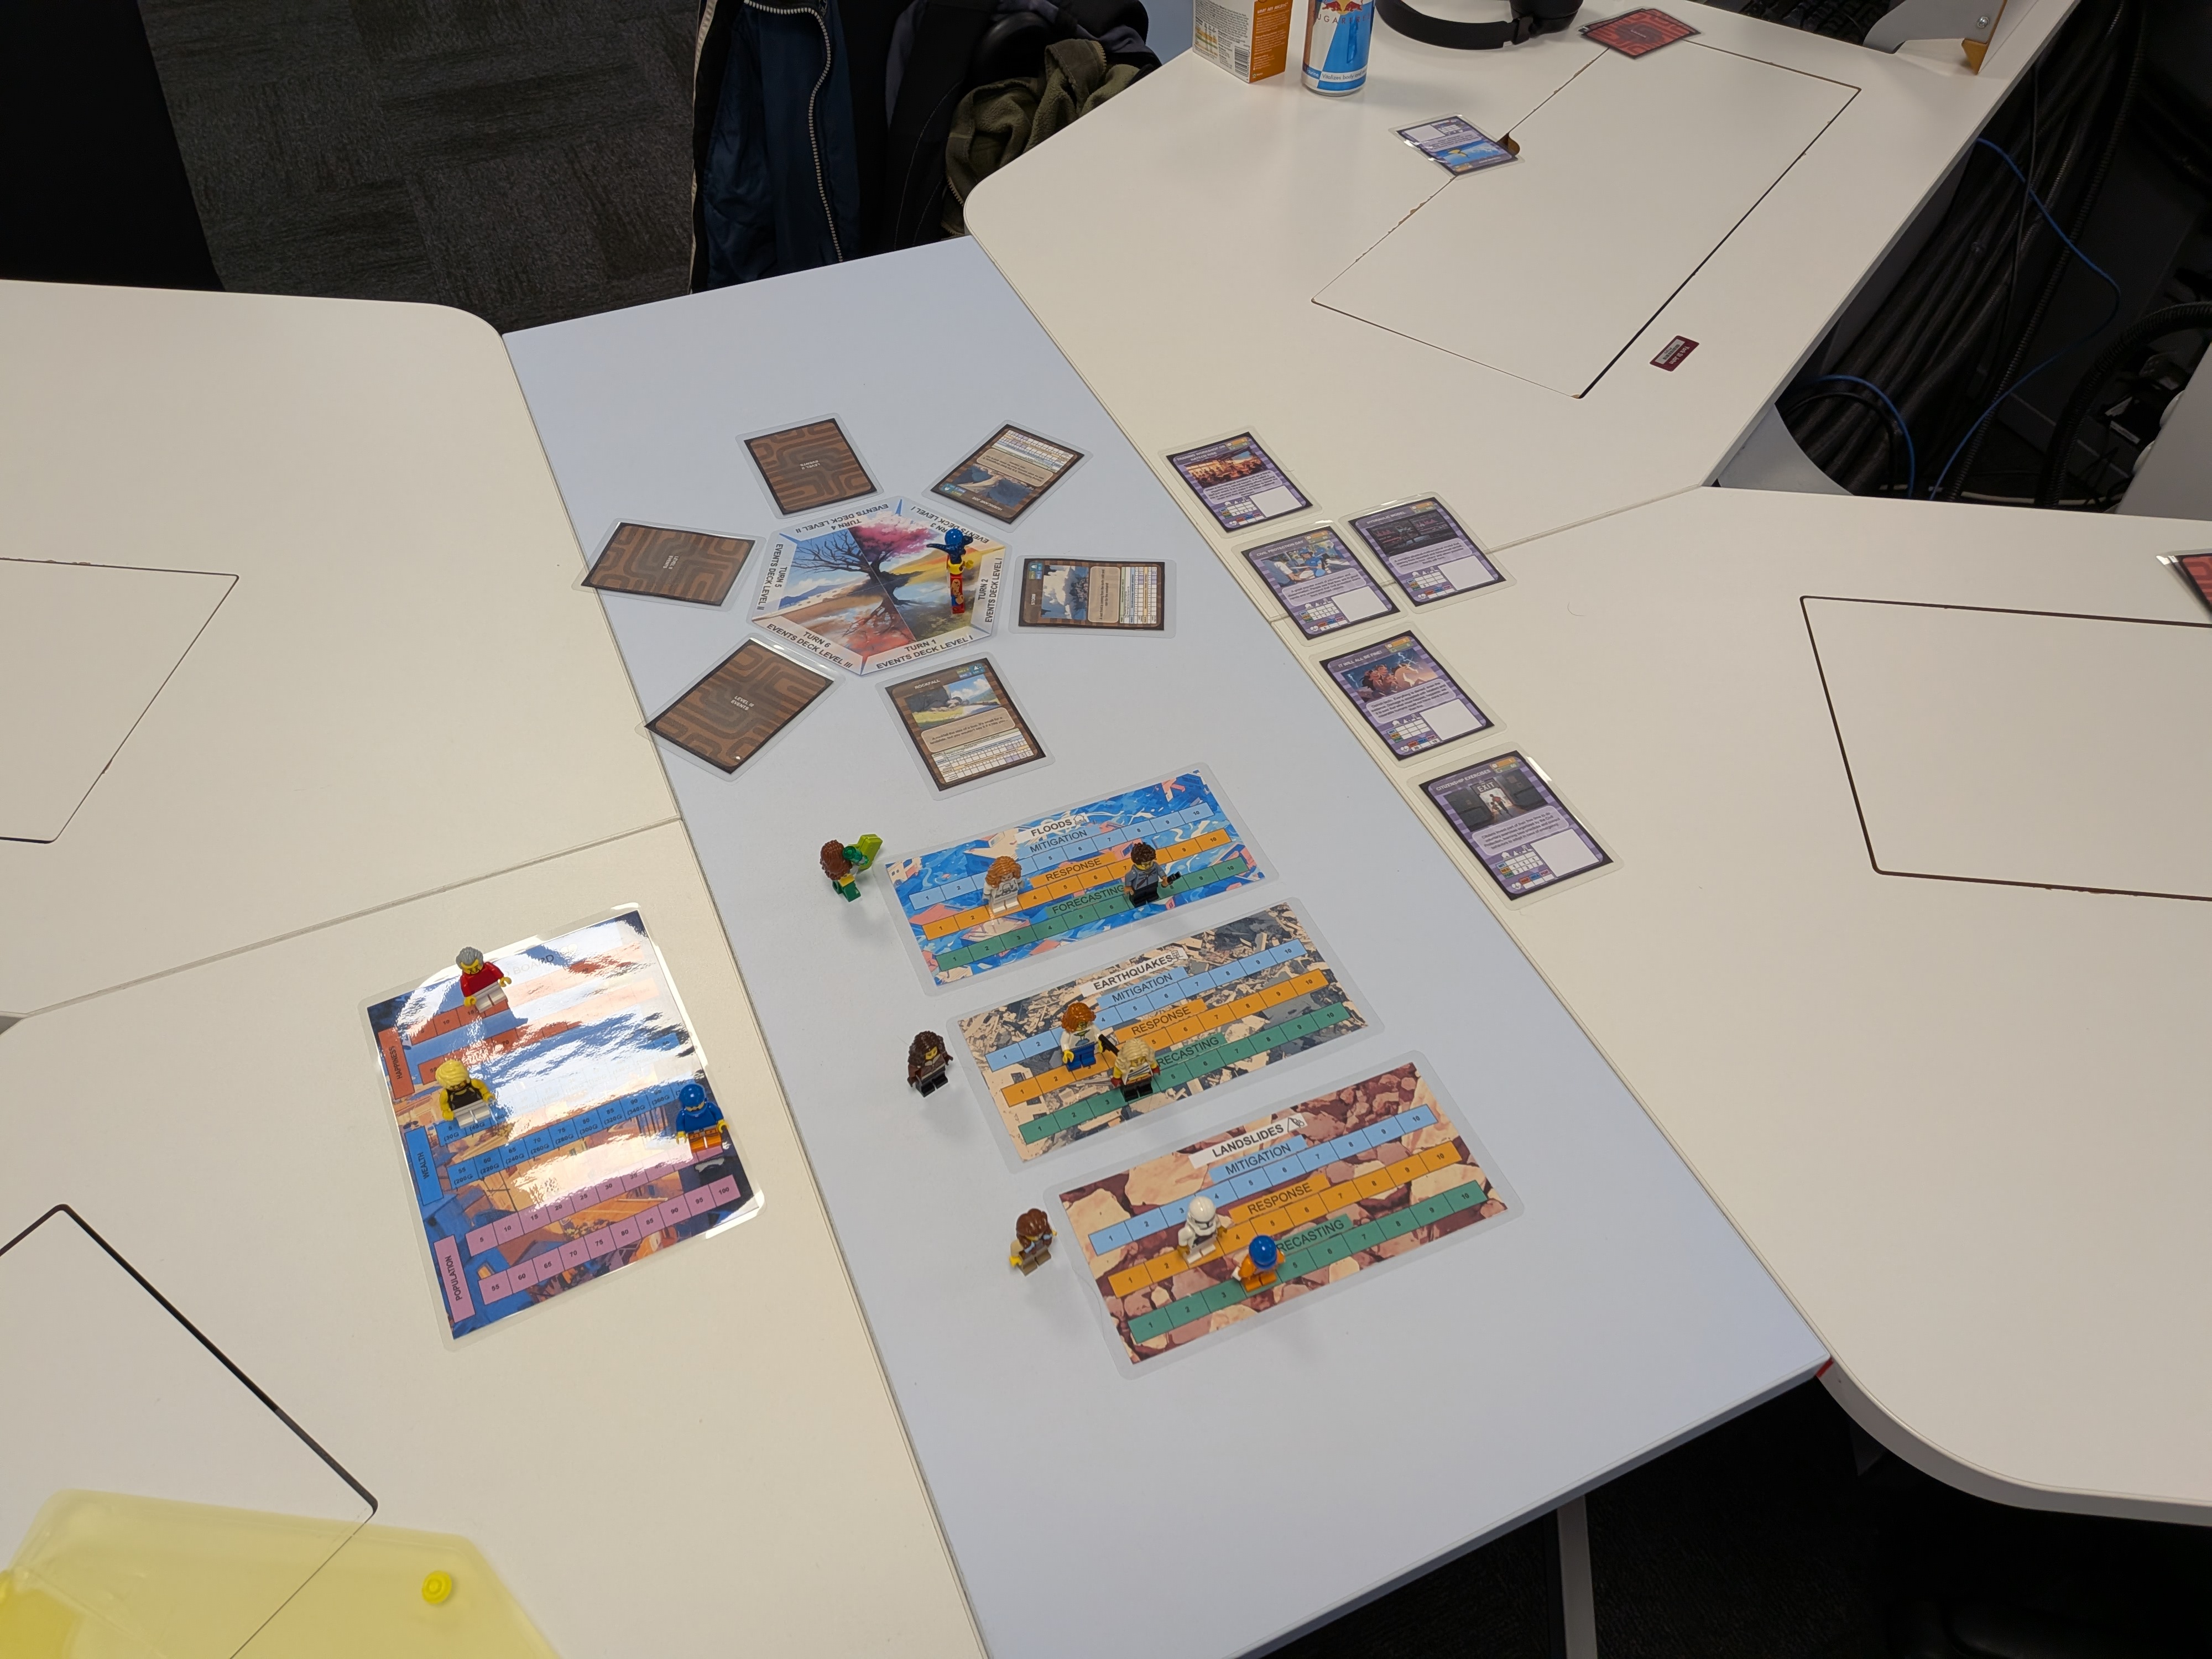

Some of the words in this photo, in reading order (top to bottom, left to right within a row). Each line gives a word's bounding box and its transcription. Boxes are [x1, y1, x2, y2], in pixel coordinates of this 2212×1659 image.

[856, 504, 889, 517] EVENTS
[980, 500, 1002, 510] HURRICANE
[831, 513, 855, 523] DECK
[917, 509, 938, 520] LEVEL
[938, 518, 958, 529] DECK
[802, 520, 830, 531] LEVEL
[838, 519, 862, 529] TURN
[961, 528, 989, 544] EVENTS
[770, 544, 784, 567] EVENTS
[1268, 543, 1294, 552] PROTECTION
[662, 555, 674, 568] EVENTS
[670, 556, 679, 566] LEVEL
[765, 568, 776, 584] DECK
[778, 567, 787, 583] TURN
[993, 561, 1001, 581] LEVEL
[760, 586, 771, 604] LEVEL
[978, 583, 988, 601] TURN
[989, 582, 998, 598] DECK
[985, 599, 995, 623] EVENTS
[766, 624, 798, 641] EVENTS
[796, 638, 818, 653] DECK
[817, 649, 844, 665] LEVEL
[803, 631, 825, 644] TURN
[904, 641, 931, 652] TURN
[876, 654, 912, 670] EVENTS
[914, 648, 939, 660] DECK
[940, 638, 968, 651] LEVEL
[915, 679, 940, 688] ROCKFALL
[731, 700, 749, 711] EVENTS
[734, 695, 749, 705] LEVEL
[1436, 779, 1464, 790] CITIZENSHIP
[1464, 769, 1490, 780] EXERCISES
[1477, 782, 1495, 791] EXIT
[1031, 819, 1073, 837] FLOODS
[1029, 830, 1088, 853] MITIGATION
[1045, 858, 1102, 881] RESPONSE
[1052, 885, 1124, 914] FORECASTING
[1093, 954, 1173, 990] EARTHQUAKES
[1112, 973, 1173, 1002] MITIGATION
[1131, 1006, 1191, 1035] RESPONSE
[1158, 1037, 1219, 1067] RECASTING
[389, 1045, 403, 1079] HAPPINESS
[1212, 1124, 1284, 1157] LANDSLIDES
[418, 1152, 430, 1180] WEALTH
[1225, 1143, 1291, 1175] MITIGATION
[718, 1187, 729, 1195] 100
[1247, 1182, 1312, 1215] RESPONSE
[1277, 1219, 1344, 1252] RECASTING
[445, 1255, 463, 1301] POPULATION
